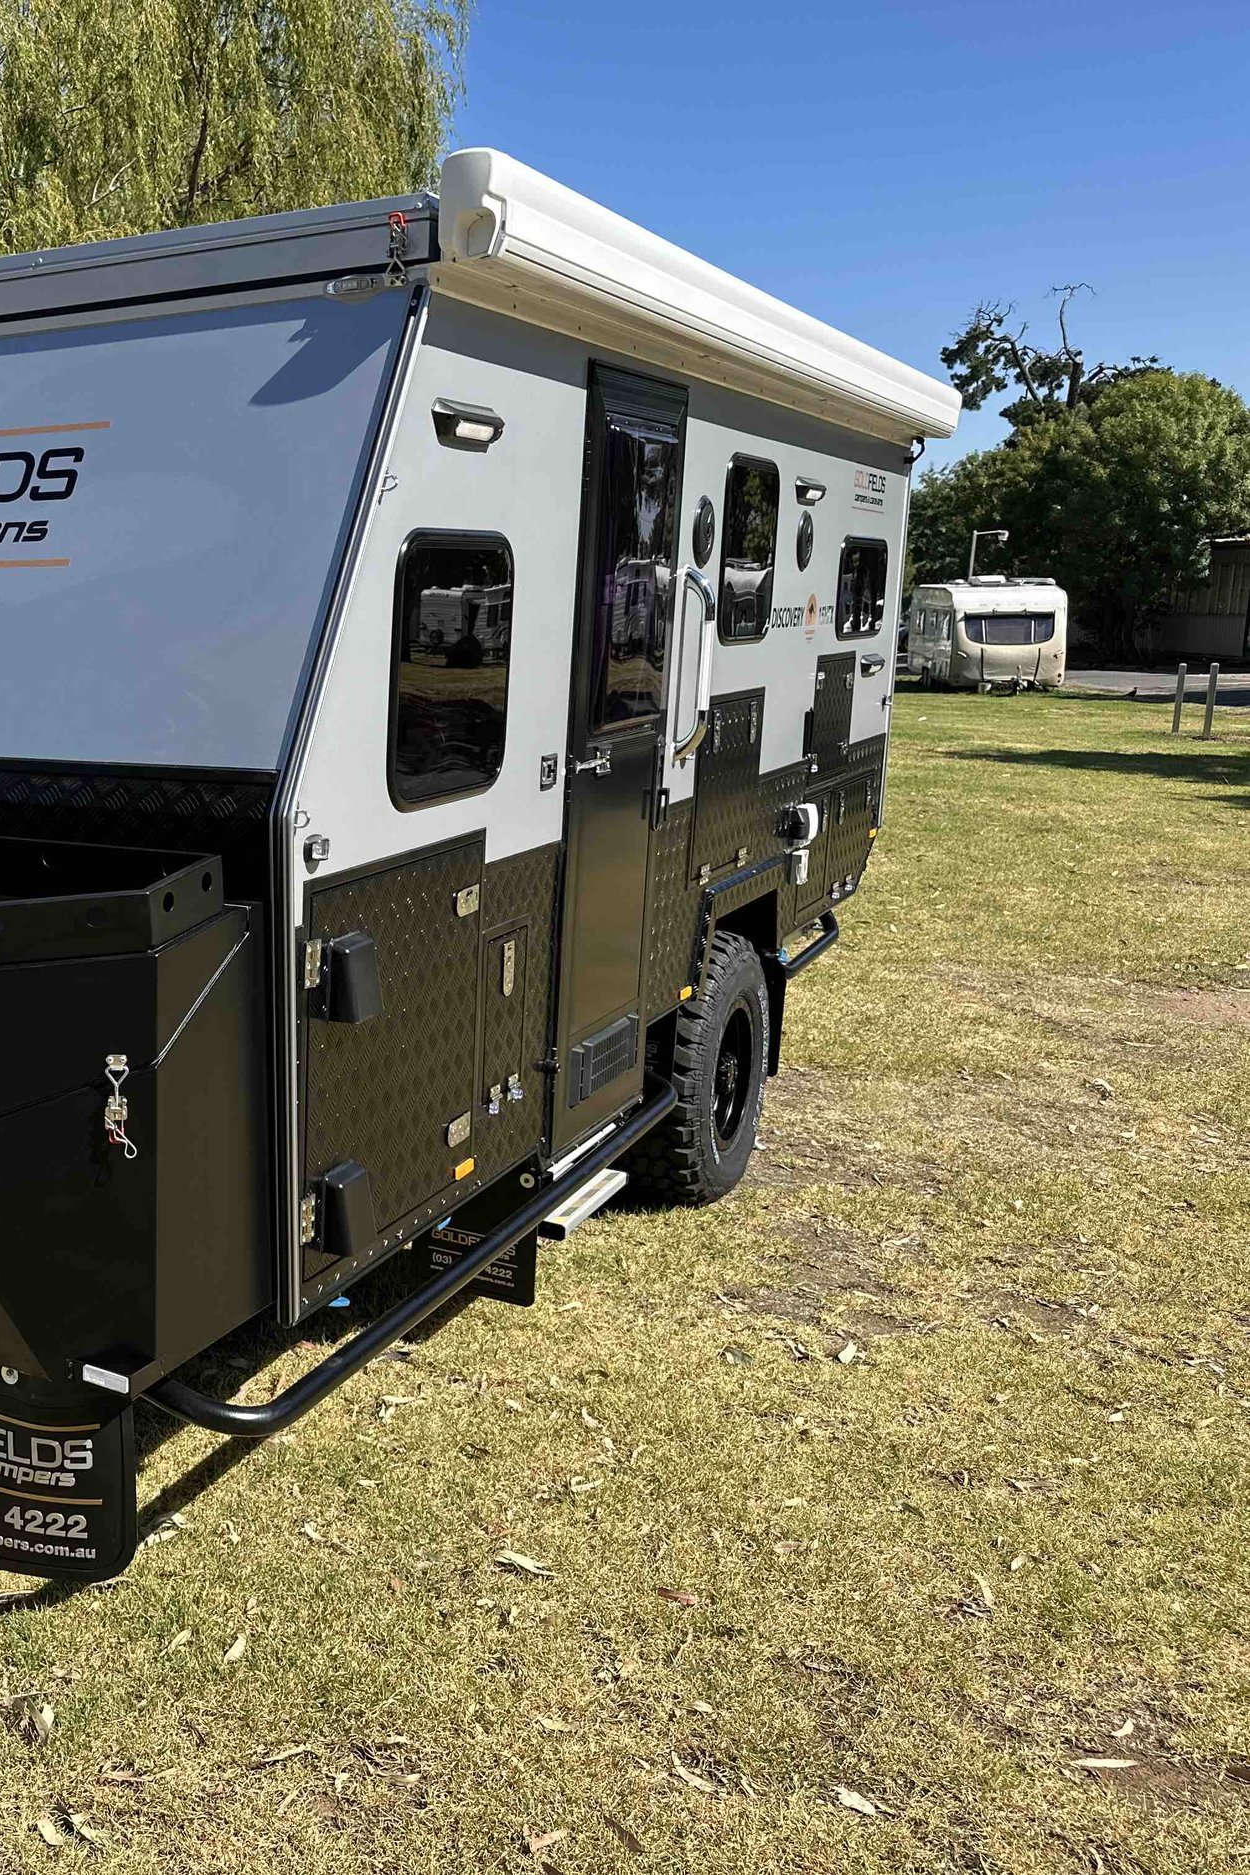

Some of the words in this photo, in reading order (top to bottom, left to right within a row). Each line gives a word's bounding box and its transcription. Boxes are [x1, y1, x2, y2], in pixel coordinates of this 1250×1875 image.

[771, 606, 805, 628] DISCOVERY
[432, 1252, 452, 1264] (03)
[4, 1505, 88, 1539] 4222
